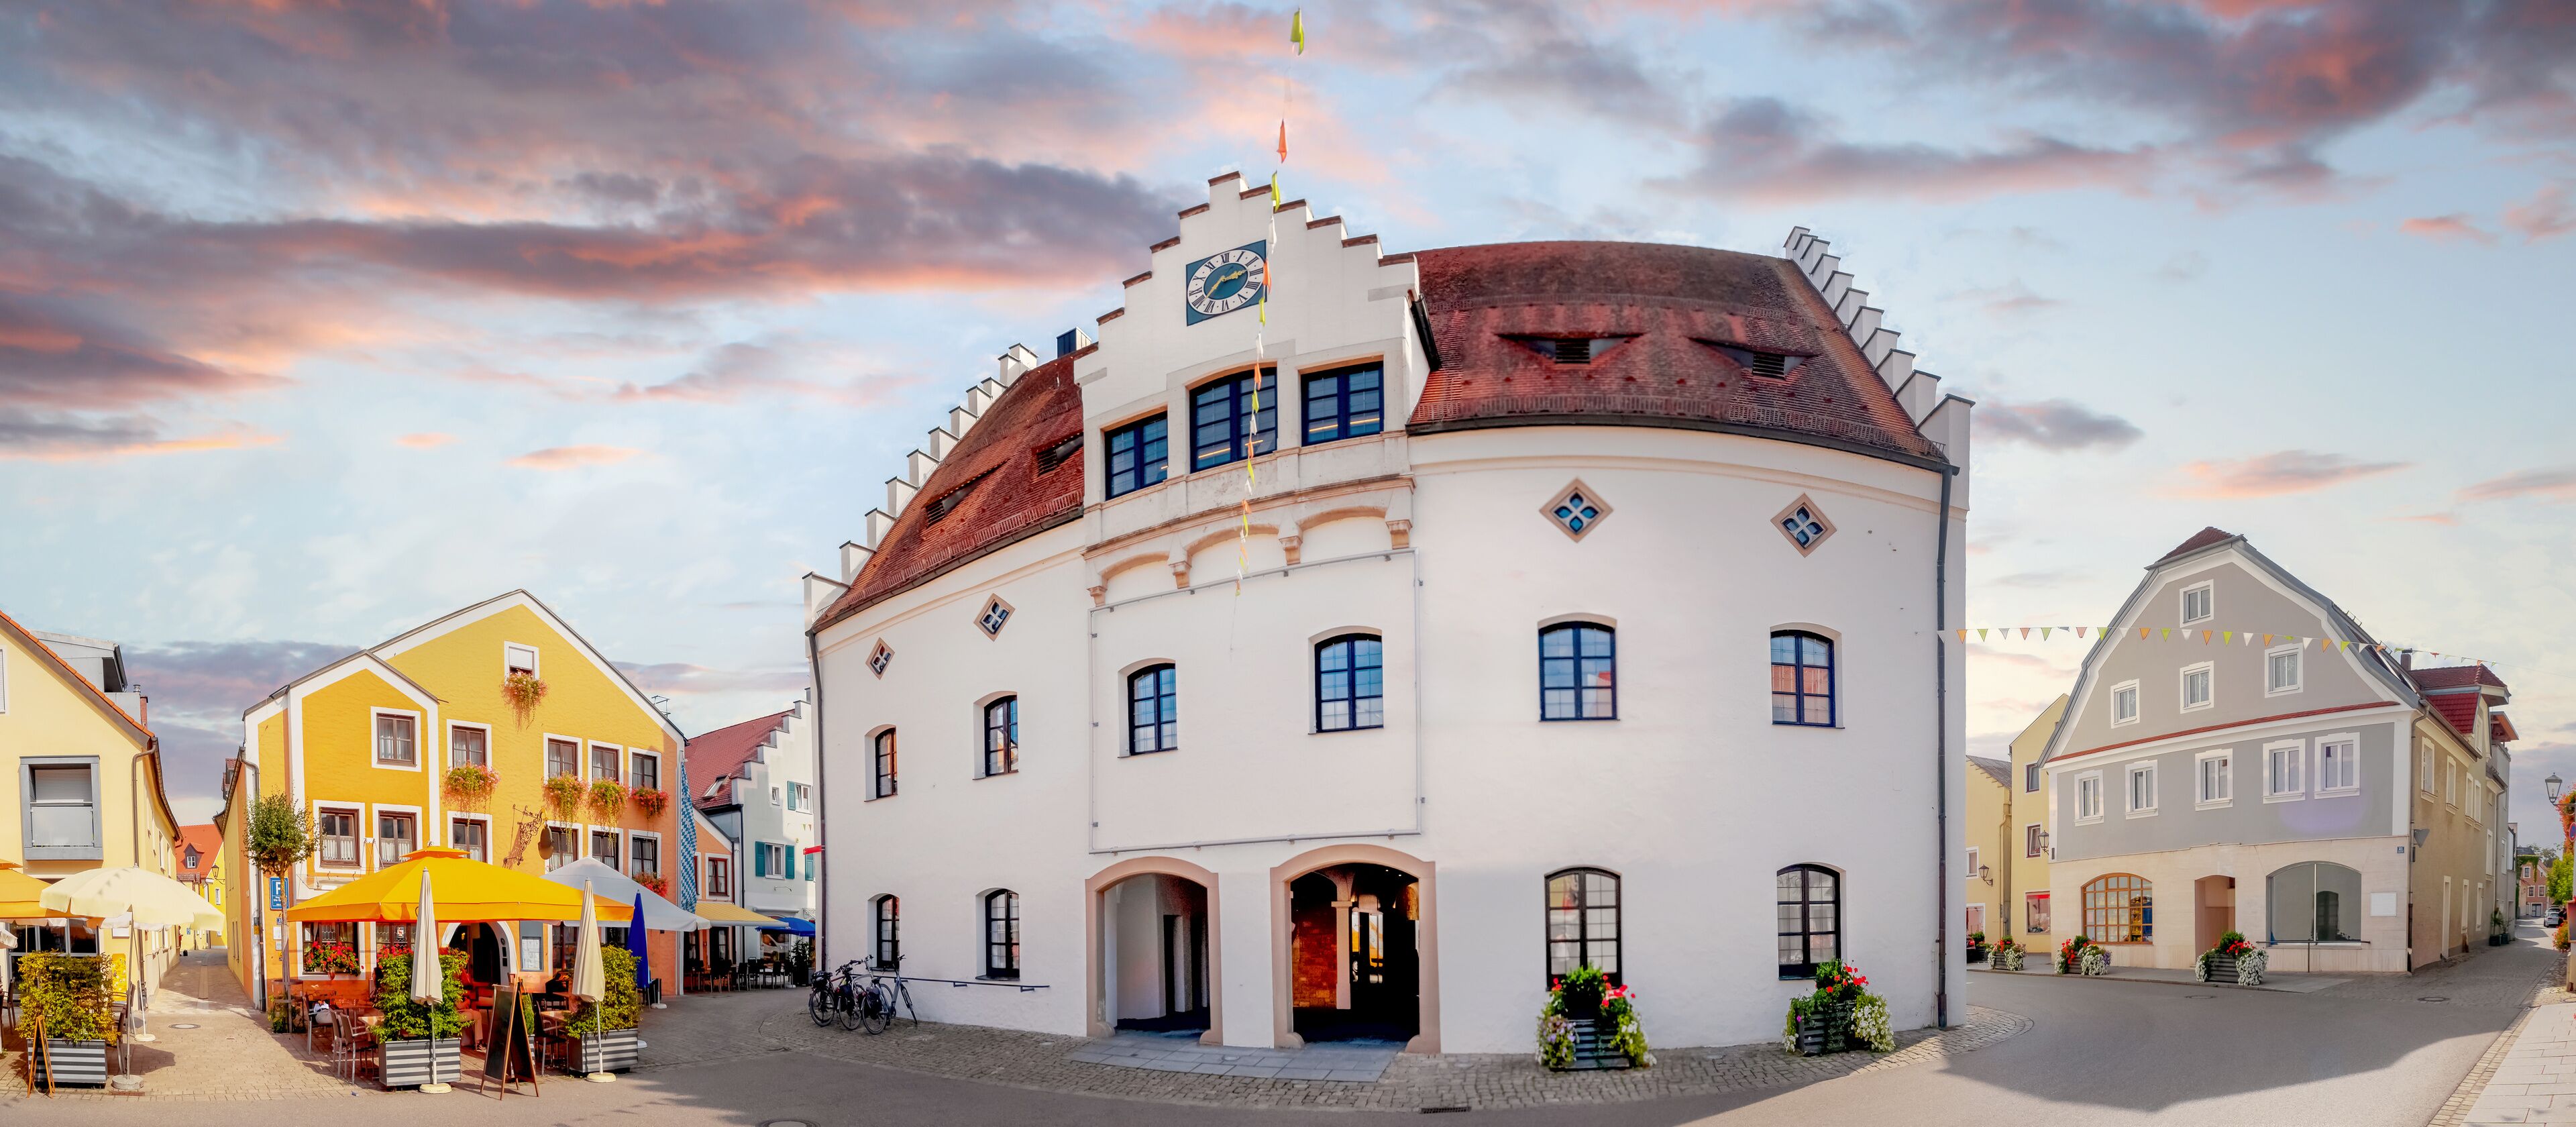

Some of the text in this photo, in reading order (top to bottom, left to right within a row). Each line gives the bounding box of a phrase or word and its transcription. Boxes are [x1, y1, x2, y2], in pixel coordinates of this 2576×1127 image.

[1221, 252, 1230, 264] XII
[1236, 252, 1245, 262] I
[1245, 256, 1259, 266] II
[1204, 262, 1216, 272] XI
[1249, 268, 1263, 276] III
[1245, 281, 1261, 290] IIII
[1189, 287, 1202, 296] IX
[1237, 294, 1248, 303] V
[1203, 301, 1216, 313] VII
[1222, 300, 1229, 311] VI
